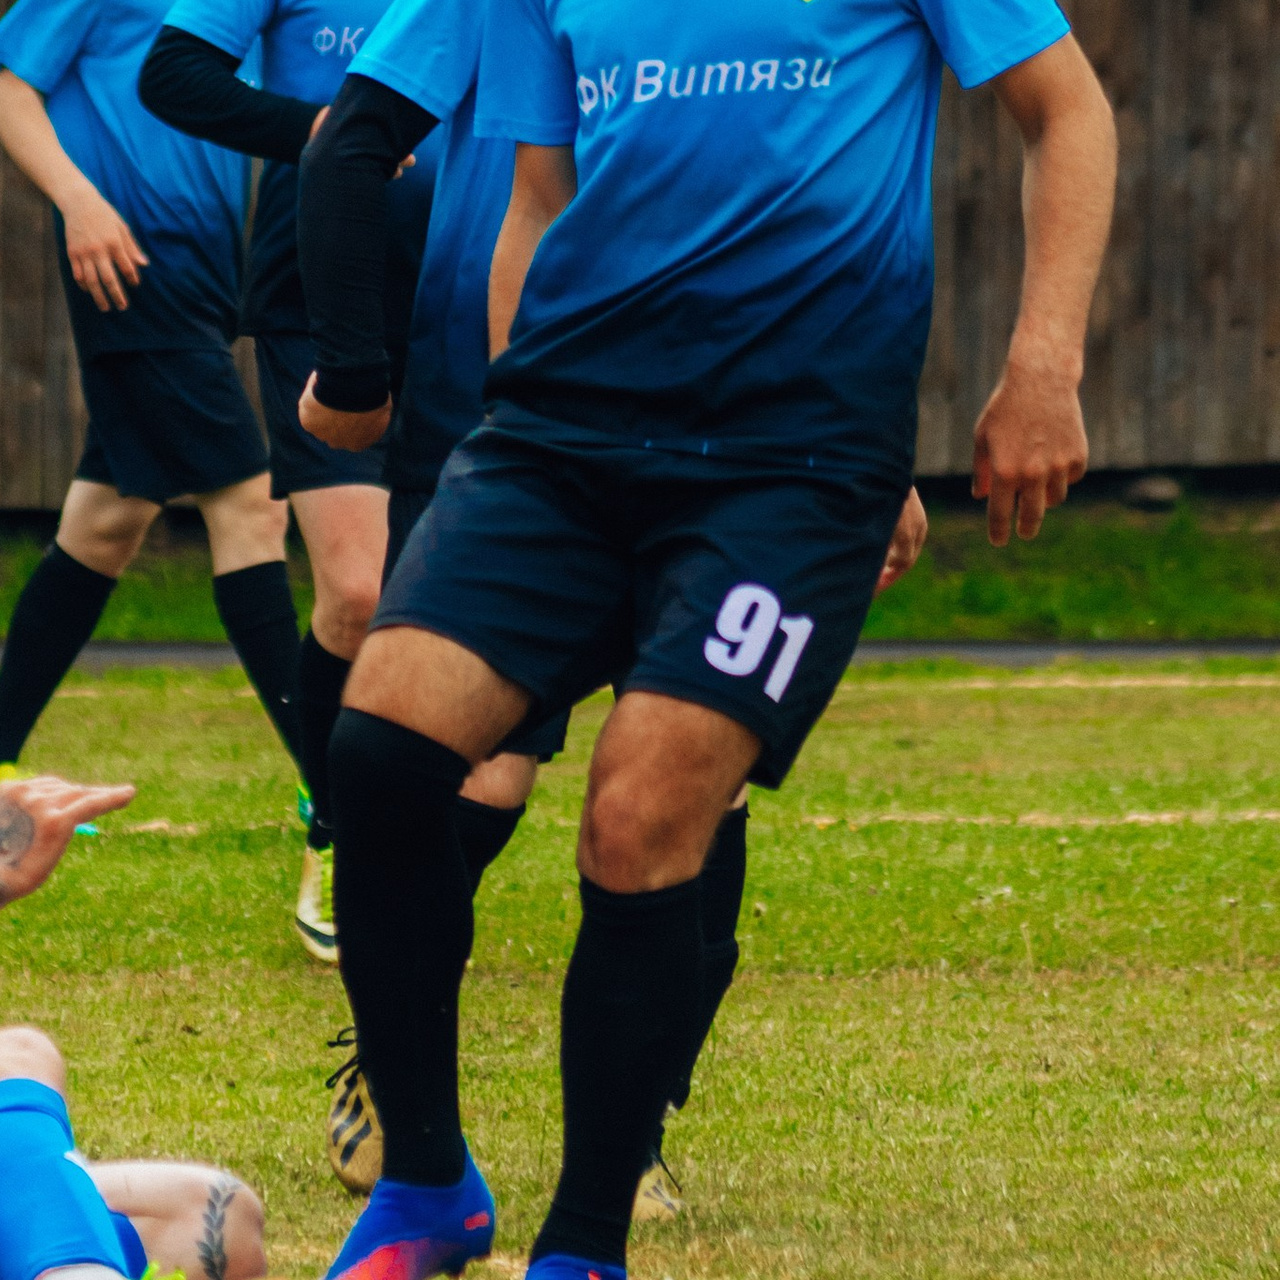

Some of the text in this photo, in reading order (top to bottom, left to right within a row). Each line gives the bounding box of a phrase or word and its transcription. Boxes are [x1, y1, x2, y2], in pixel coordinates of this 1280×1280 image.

[314, 26, 365, 55] ФК
[633, 58, 838, 103] Витязи
[703, 584, 815, 704] 91
